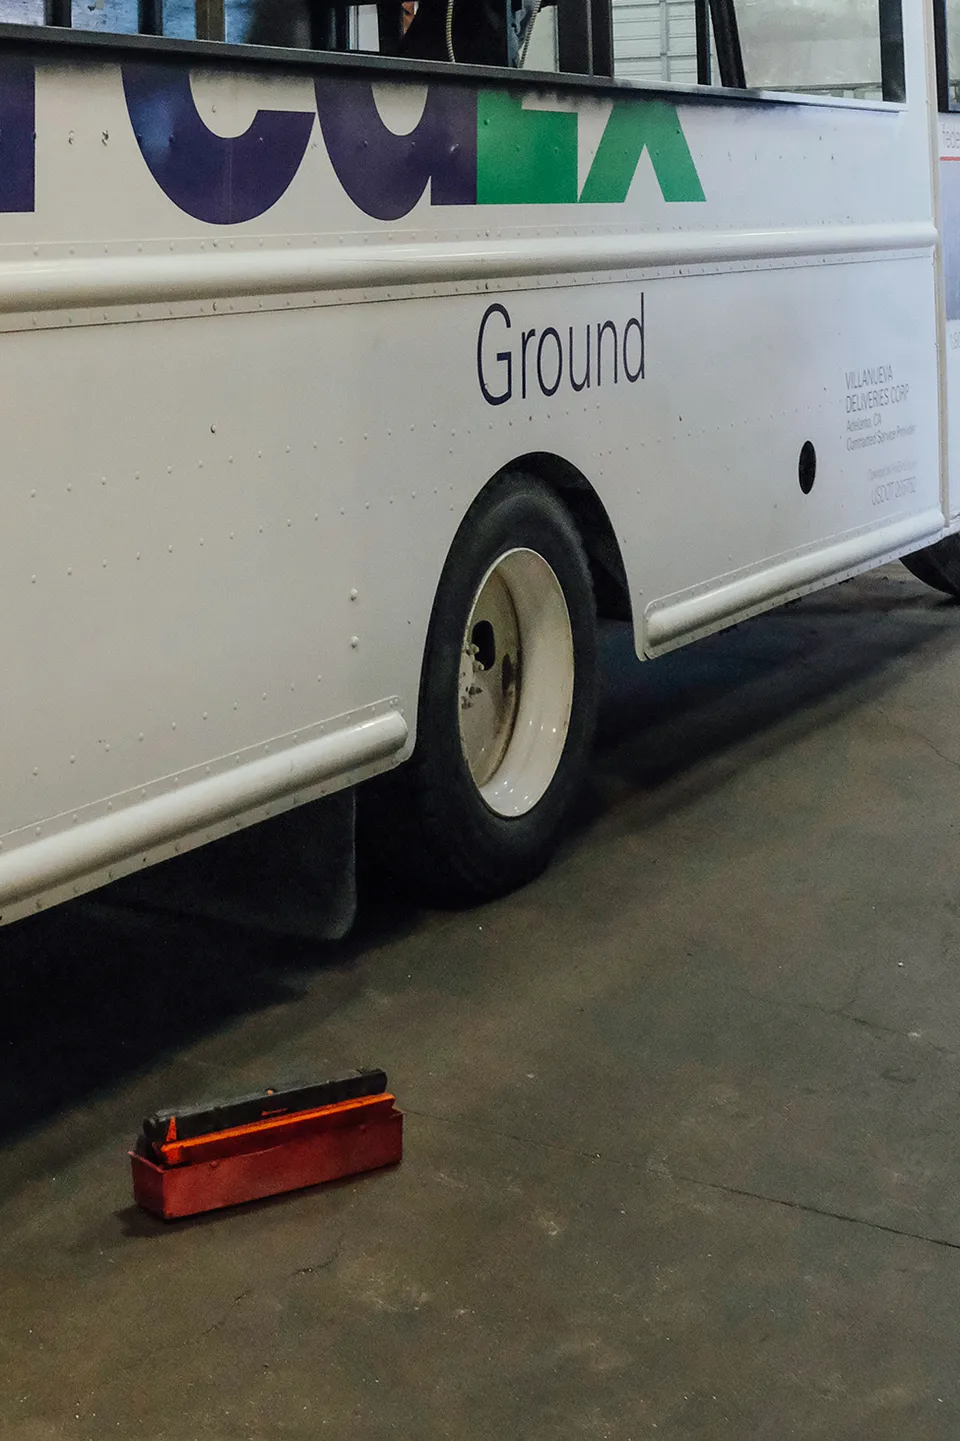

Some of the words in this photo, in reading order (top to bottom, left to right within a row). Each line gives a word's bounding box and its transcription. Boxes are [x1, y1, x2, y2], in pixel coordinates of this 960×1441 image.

[477, 292, 645, 406] Ground
[845, 364, 893, 390] VILLANUEVA
[846, 388, 889, 413] DELIVERIES
[891, 383, 909, 404] CORP
